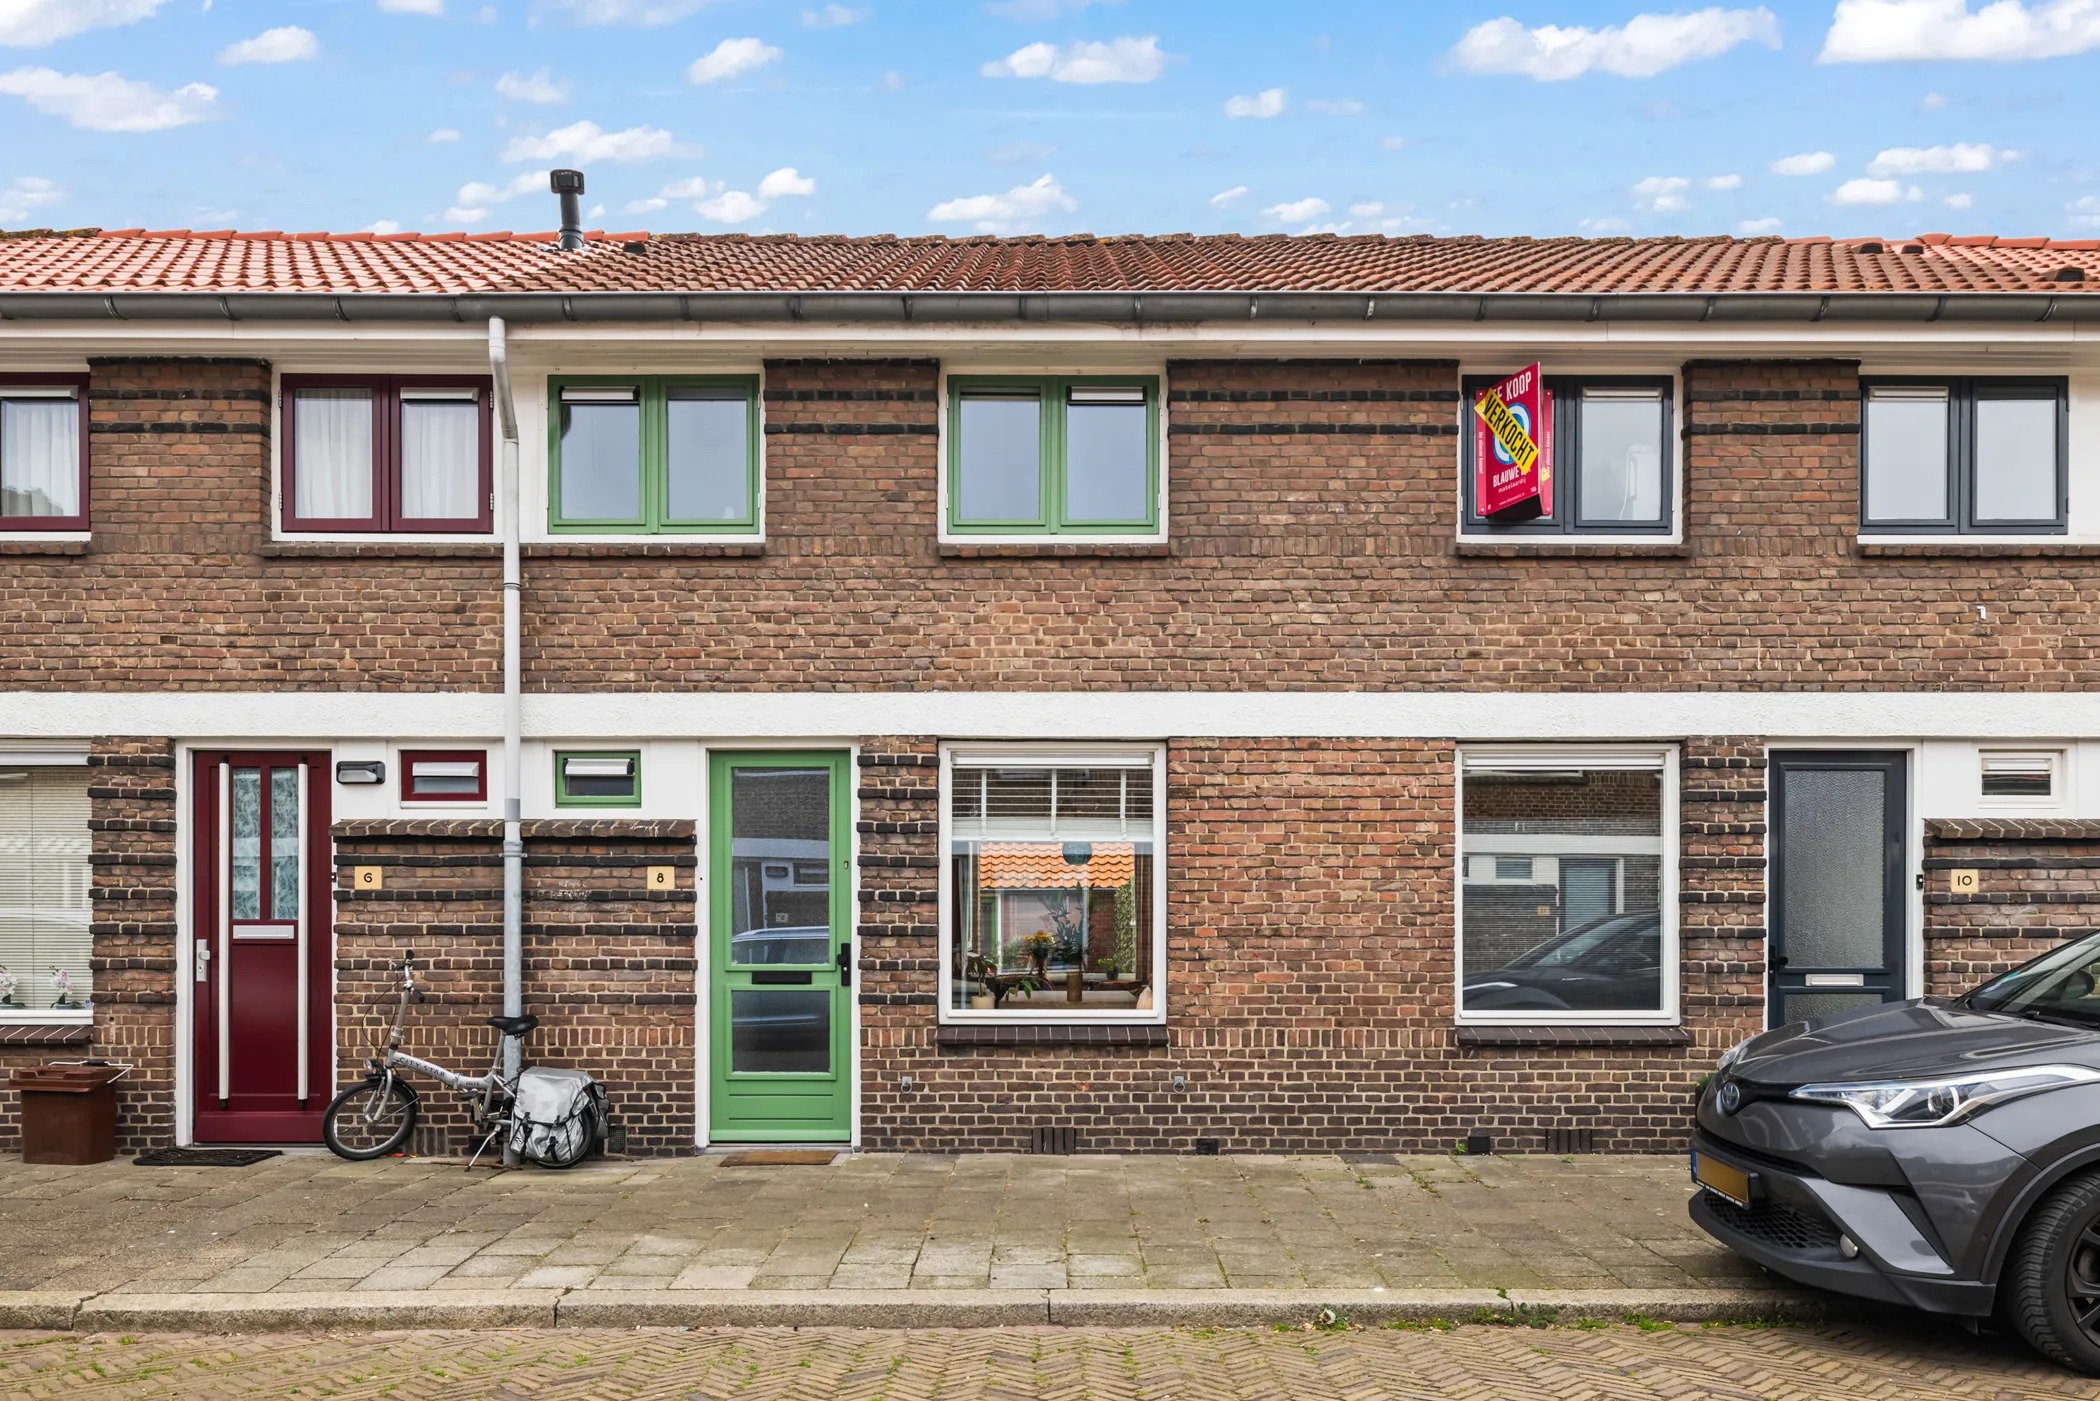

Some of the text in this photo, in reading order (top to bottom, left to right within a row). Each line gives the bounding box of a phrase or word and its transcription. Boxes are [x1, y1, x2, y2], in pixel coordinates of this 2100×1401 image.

[1506, 371, 1532, 402] KOOP
[1483, 394, 1535, 466] VERKOCHT
[1493, 465, 1519, 488] BLAUWE
[1498, 477, 1527, 493] makelaardij
[363, 872, 373, 883] 6
[656, 872, 665, 883] 8
[1957, 875, 1973, 886] 10
[400, 1056, 446, 1078] CITY STAR
